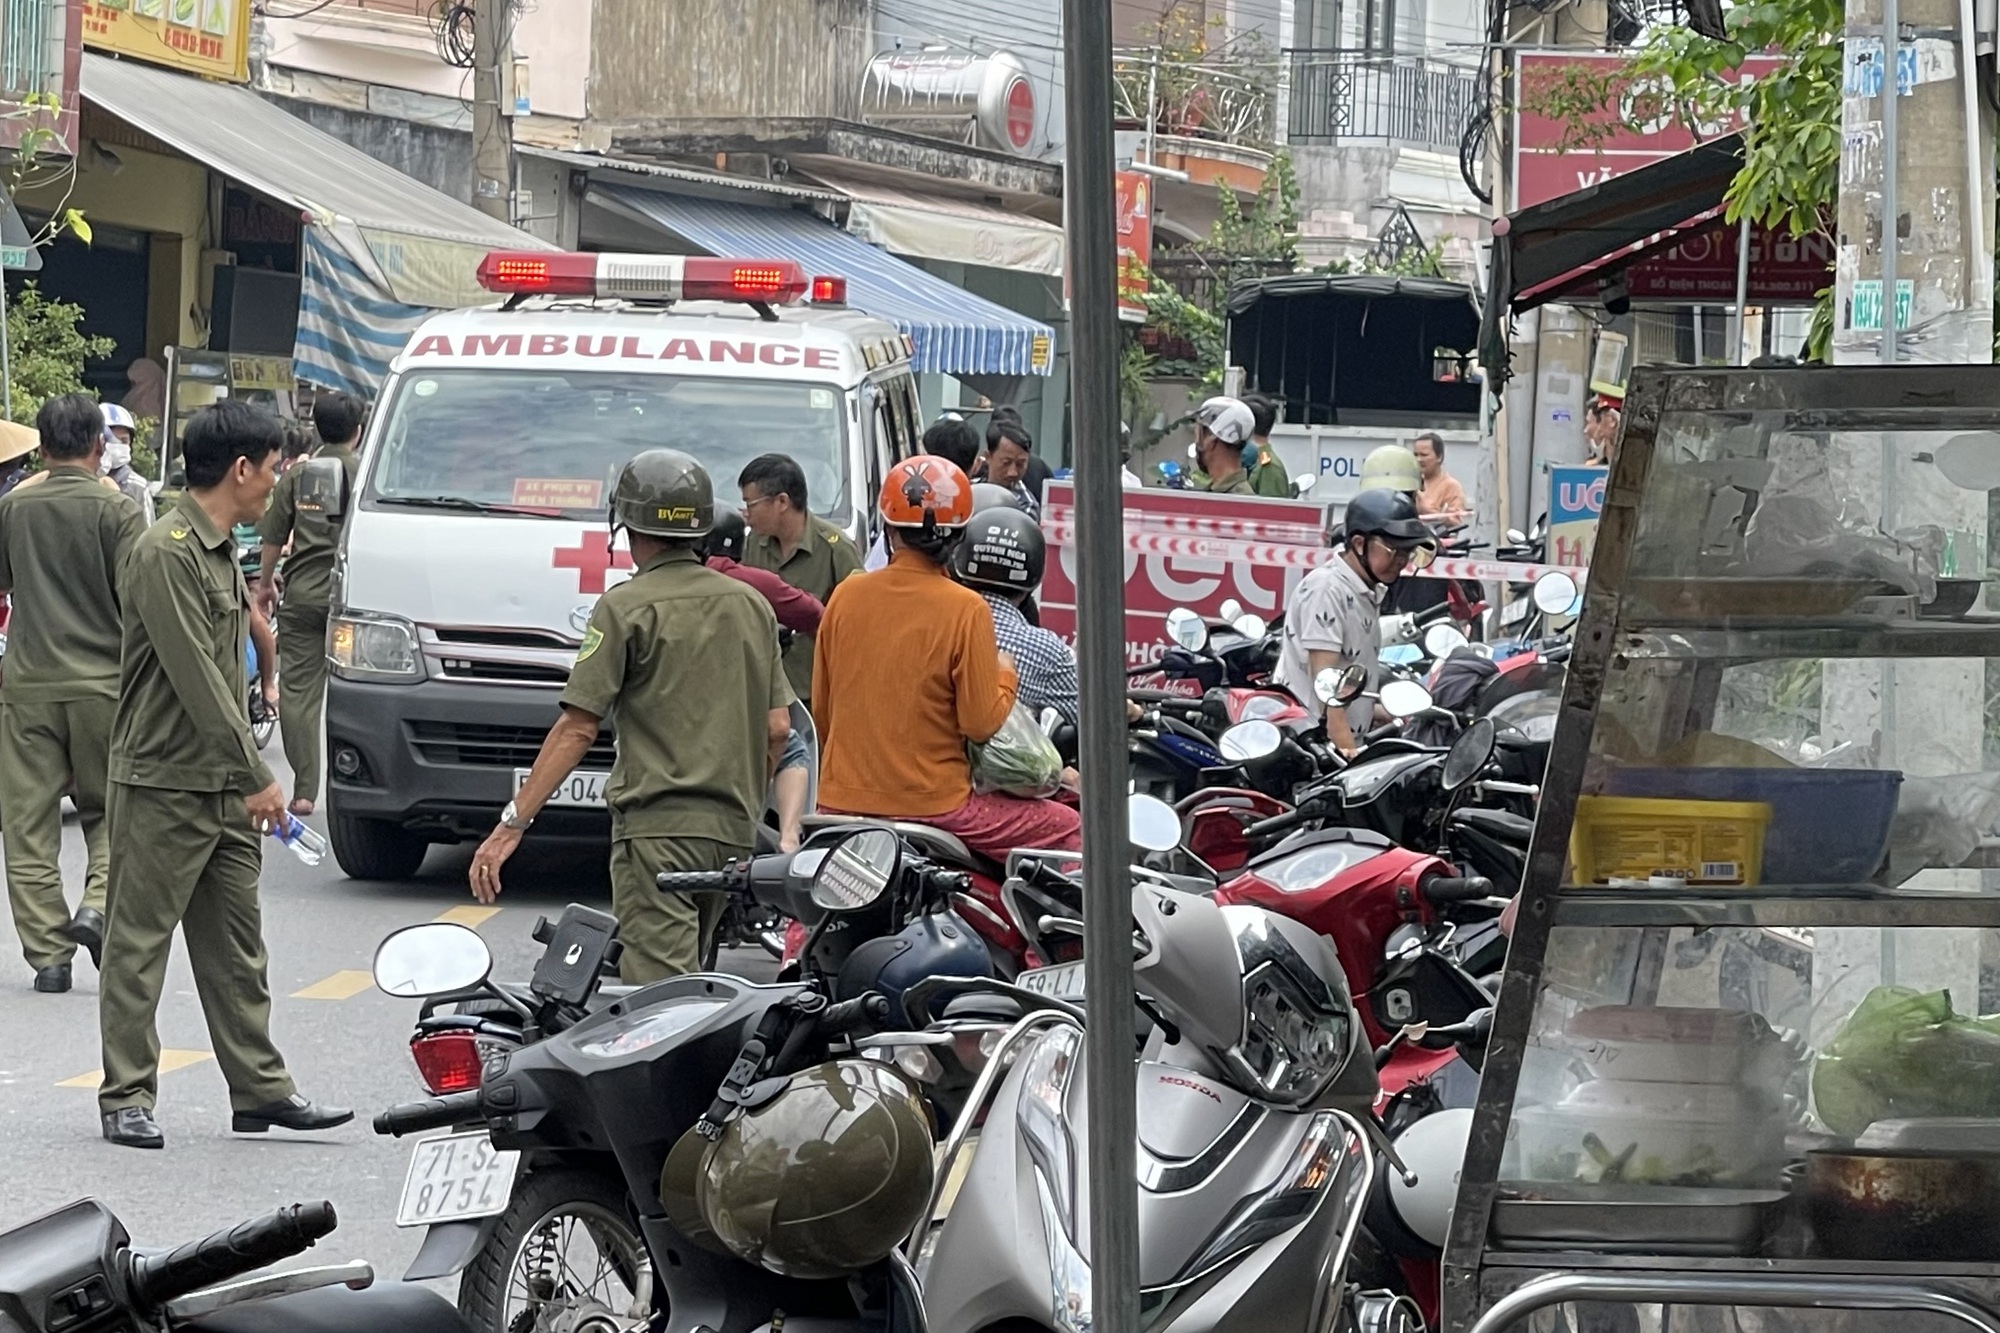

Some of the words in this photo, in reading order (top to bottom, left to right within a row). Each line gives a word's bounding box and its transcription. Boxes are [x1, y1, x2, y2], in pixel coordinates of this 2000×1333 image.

[1577, 166, 1623, 190] VĂ
[409, 334, 840, 371] AMBULANCE
[1320, 457, 1366, 478] POL
[416, 1174, 492, 1216] 8754
